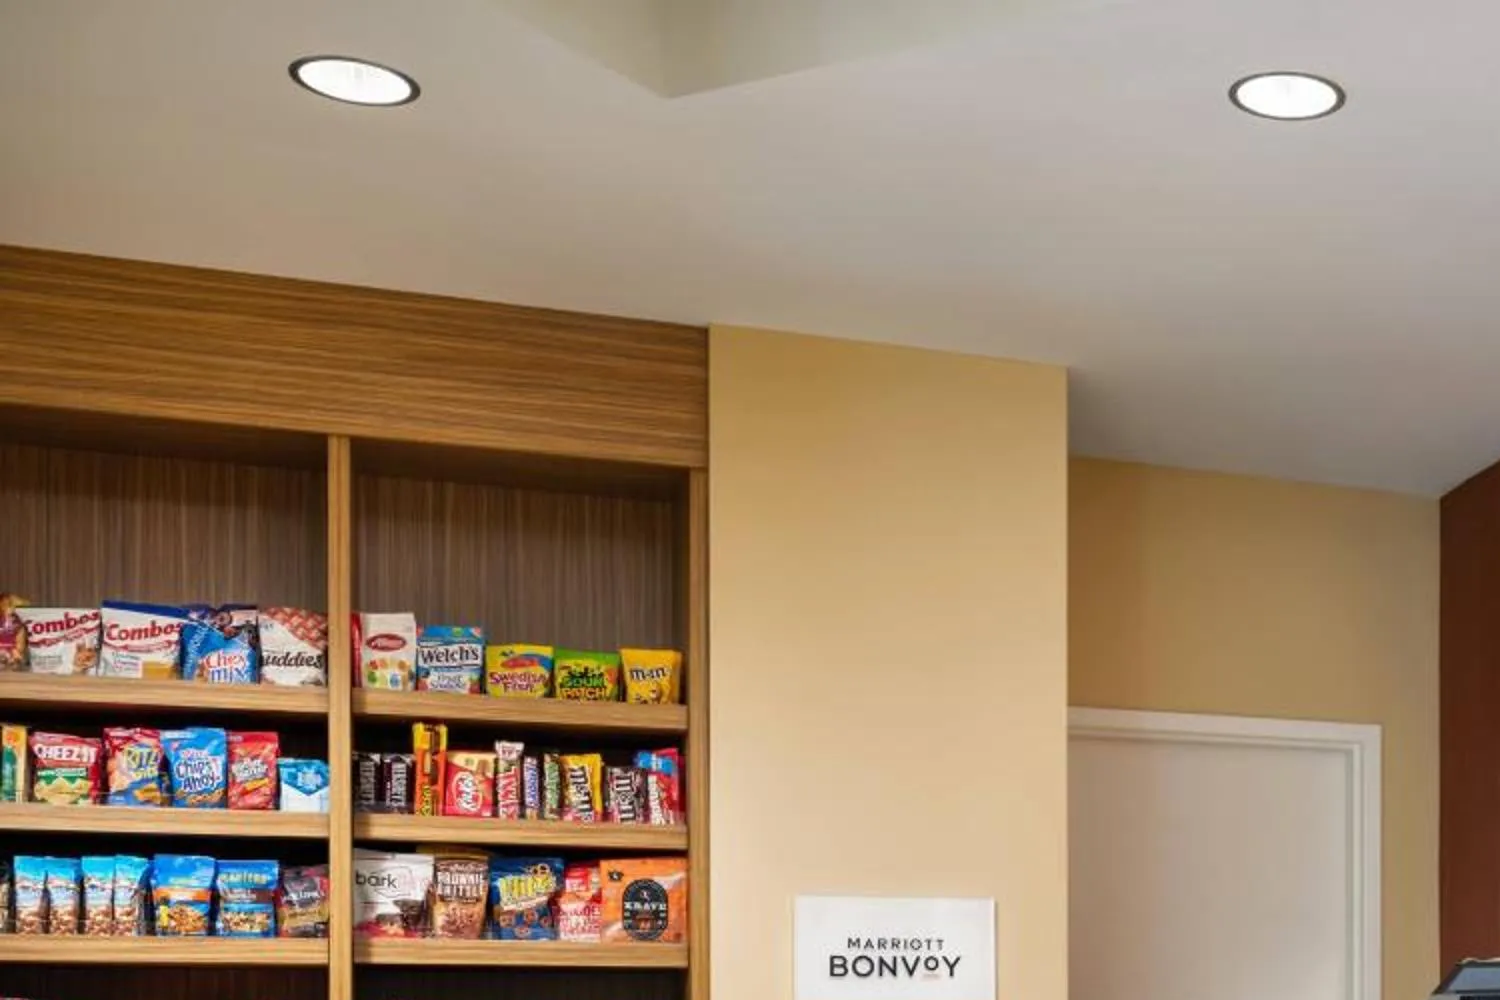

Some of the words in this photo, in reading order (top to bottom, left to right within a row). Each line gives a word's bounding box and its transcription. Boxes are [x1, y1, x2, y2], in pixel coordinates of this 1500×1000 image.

[262, 651, 325, 669] uddies
[421, 646, 479, 664] Welch's
[355, 869, 397, 889] bark
[847, 937, 944, 950] MARRIOTT
[829, 955, 961, 977] BONVOY
